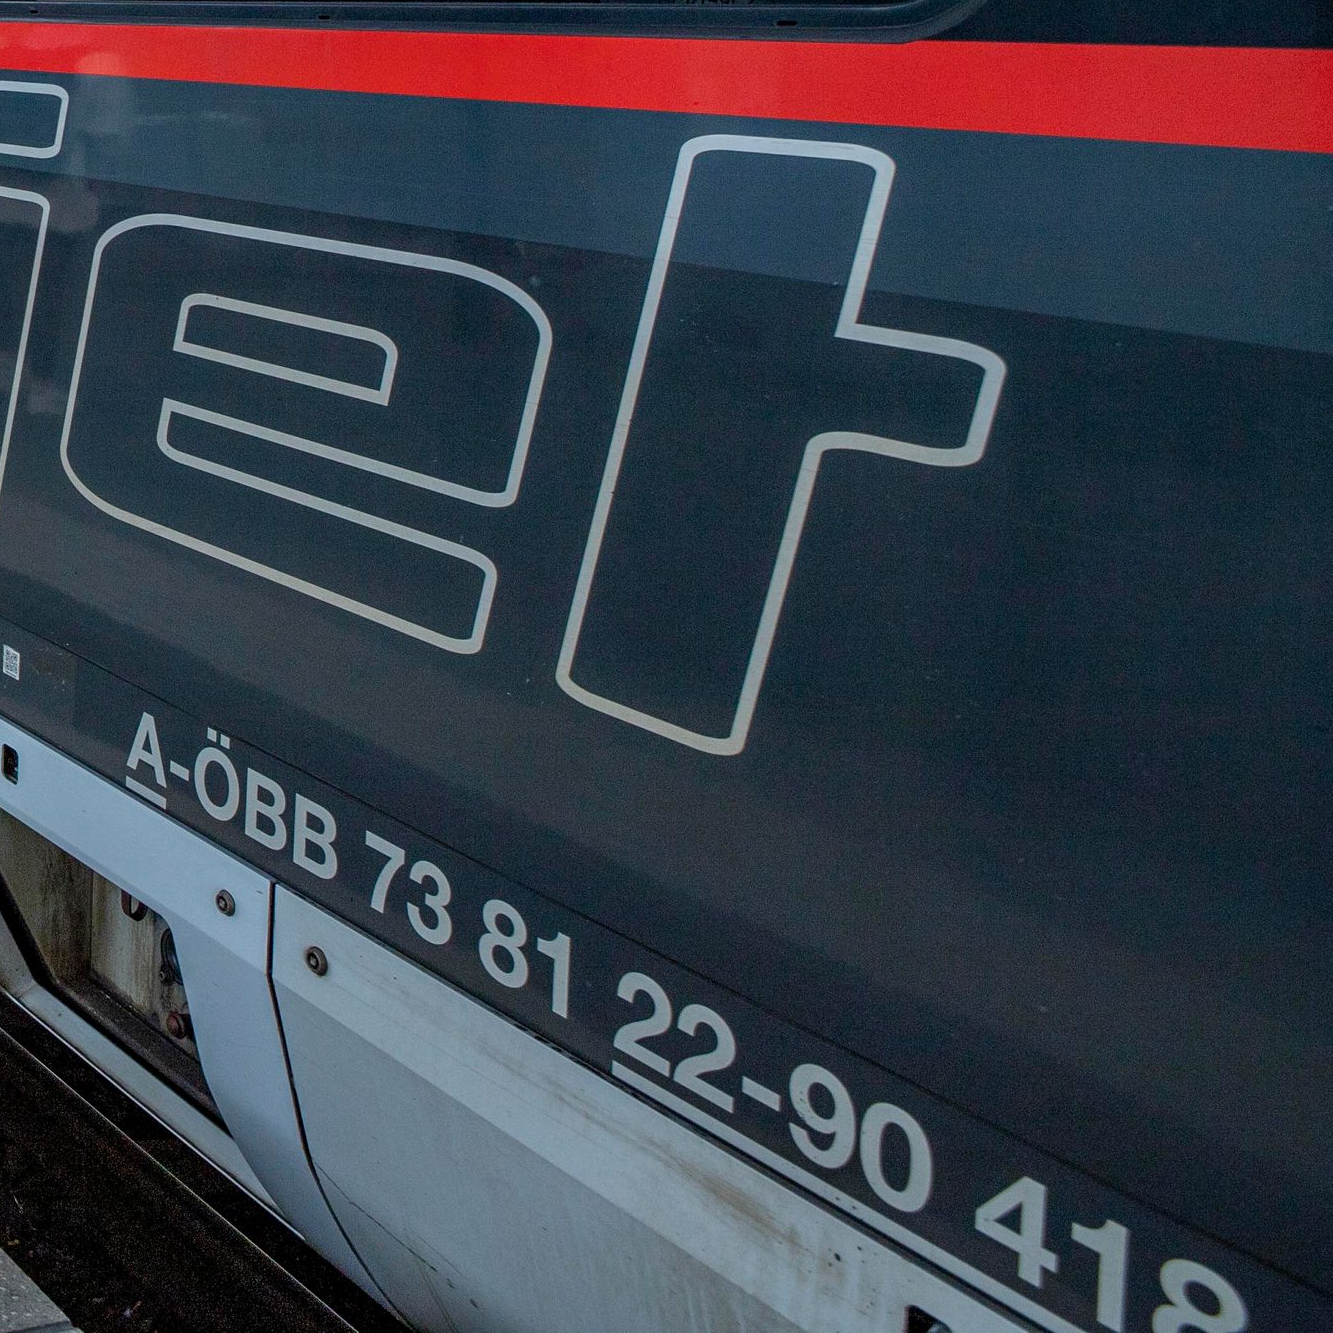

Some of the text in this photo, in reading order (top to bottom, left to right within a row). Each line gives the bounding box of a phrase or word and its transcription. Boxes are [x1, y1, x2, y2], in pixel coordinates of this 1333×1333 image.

[125, 710, 1246, 1333] A-ÖBB 73 81 22-90 418
